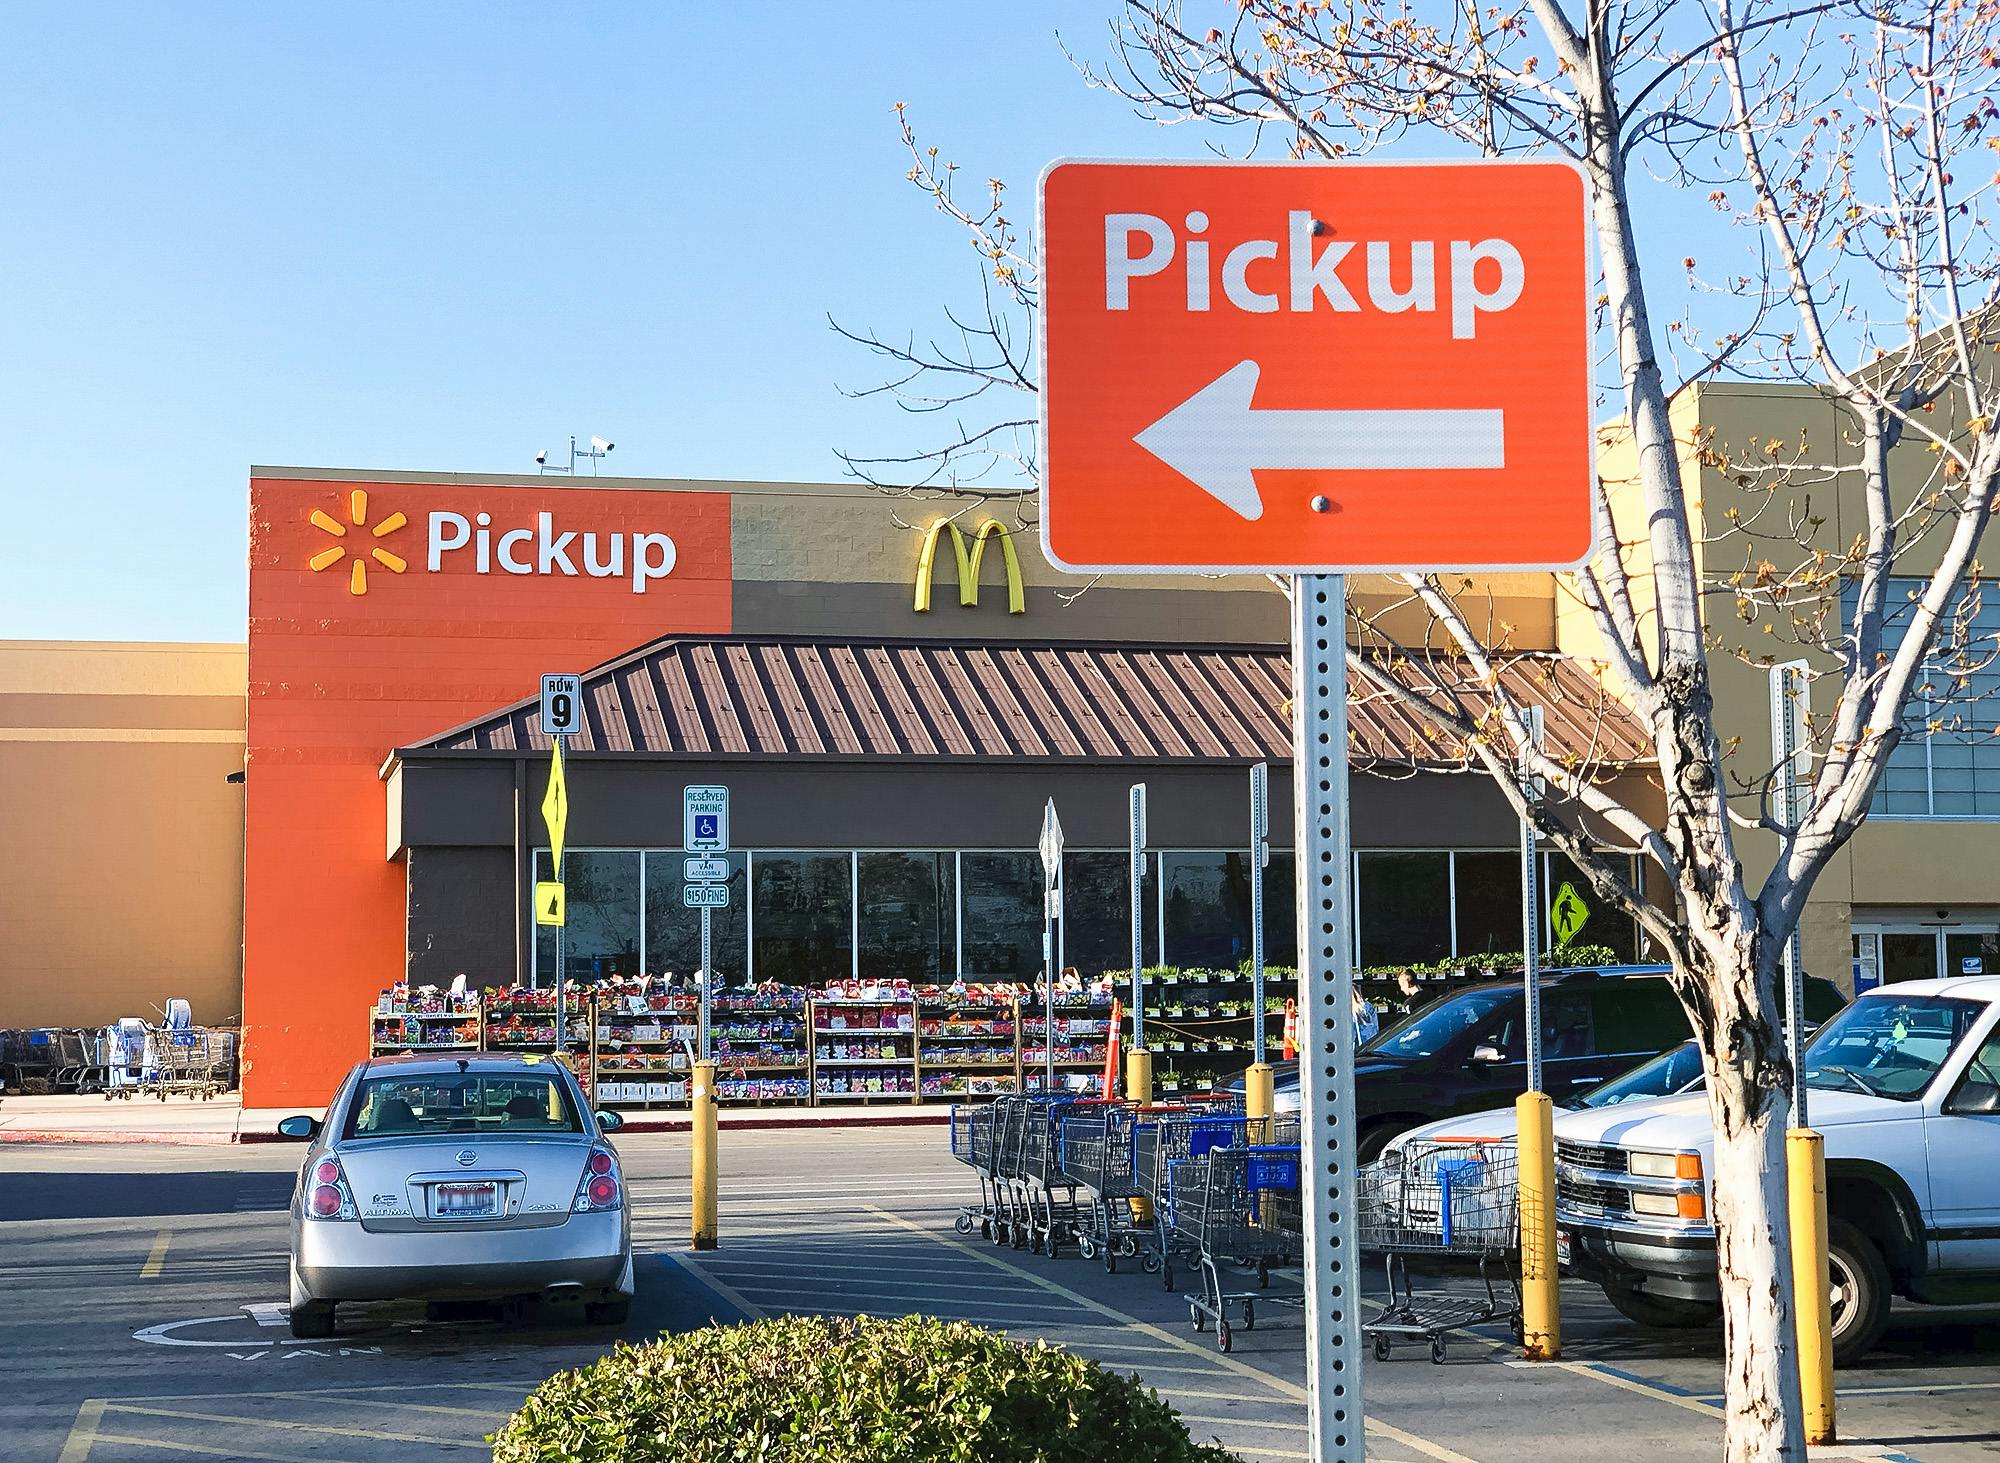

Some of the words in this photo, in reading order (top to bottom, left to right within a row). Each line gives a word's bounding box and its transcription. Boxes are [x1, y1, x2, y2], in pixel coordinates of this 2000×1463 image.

[1104, 210, 1526, 340] Pickup
[427, 511, 677, 595] Pickup
[548, 681, 574, 692] ROW
[552, 694, 572, 727] 9
[687, 792, 726, 801] RESERVED
[690, 803, 723, 812] PARKING
[687, 889, 706, 902] $150
[707, 890, 725, 902] FINE
[363, 1208, 410, 1217] ALTIMA
